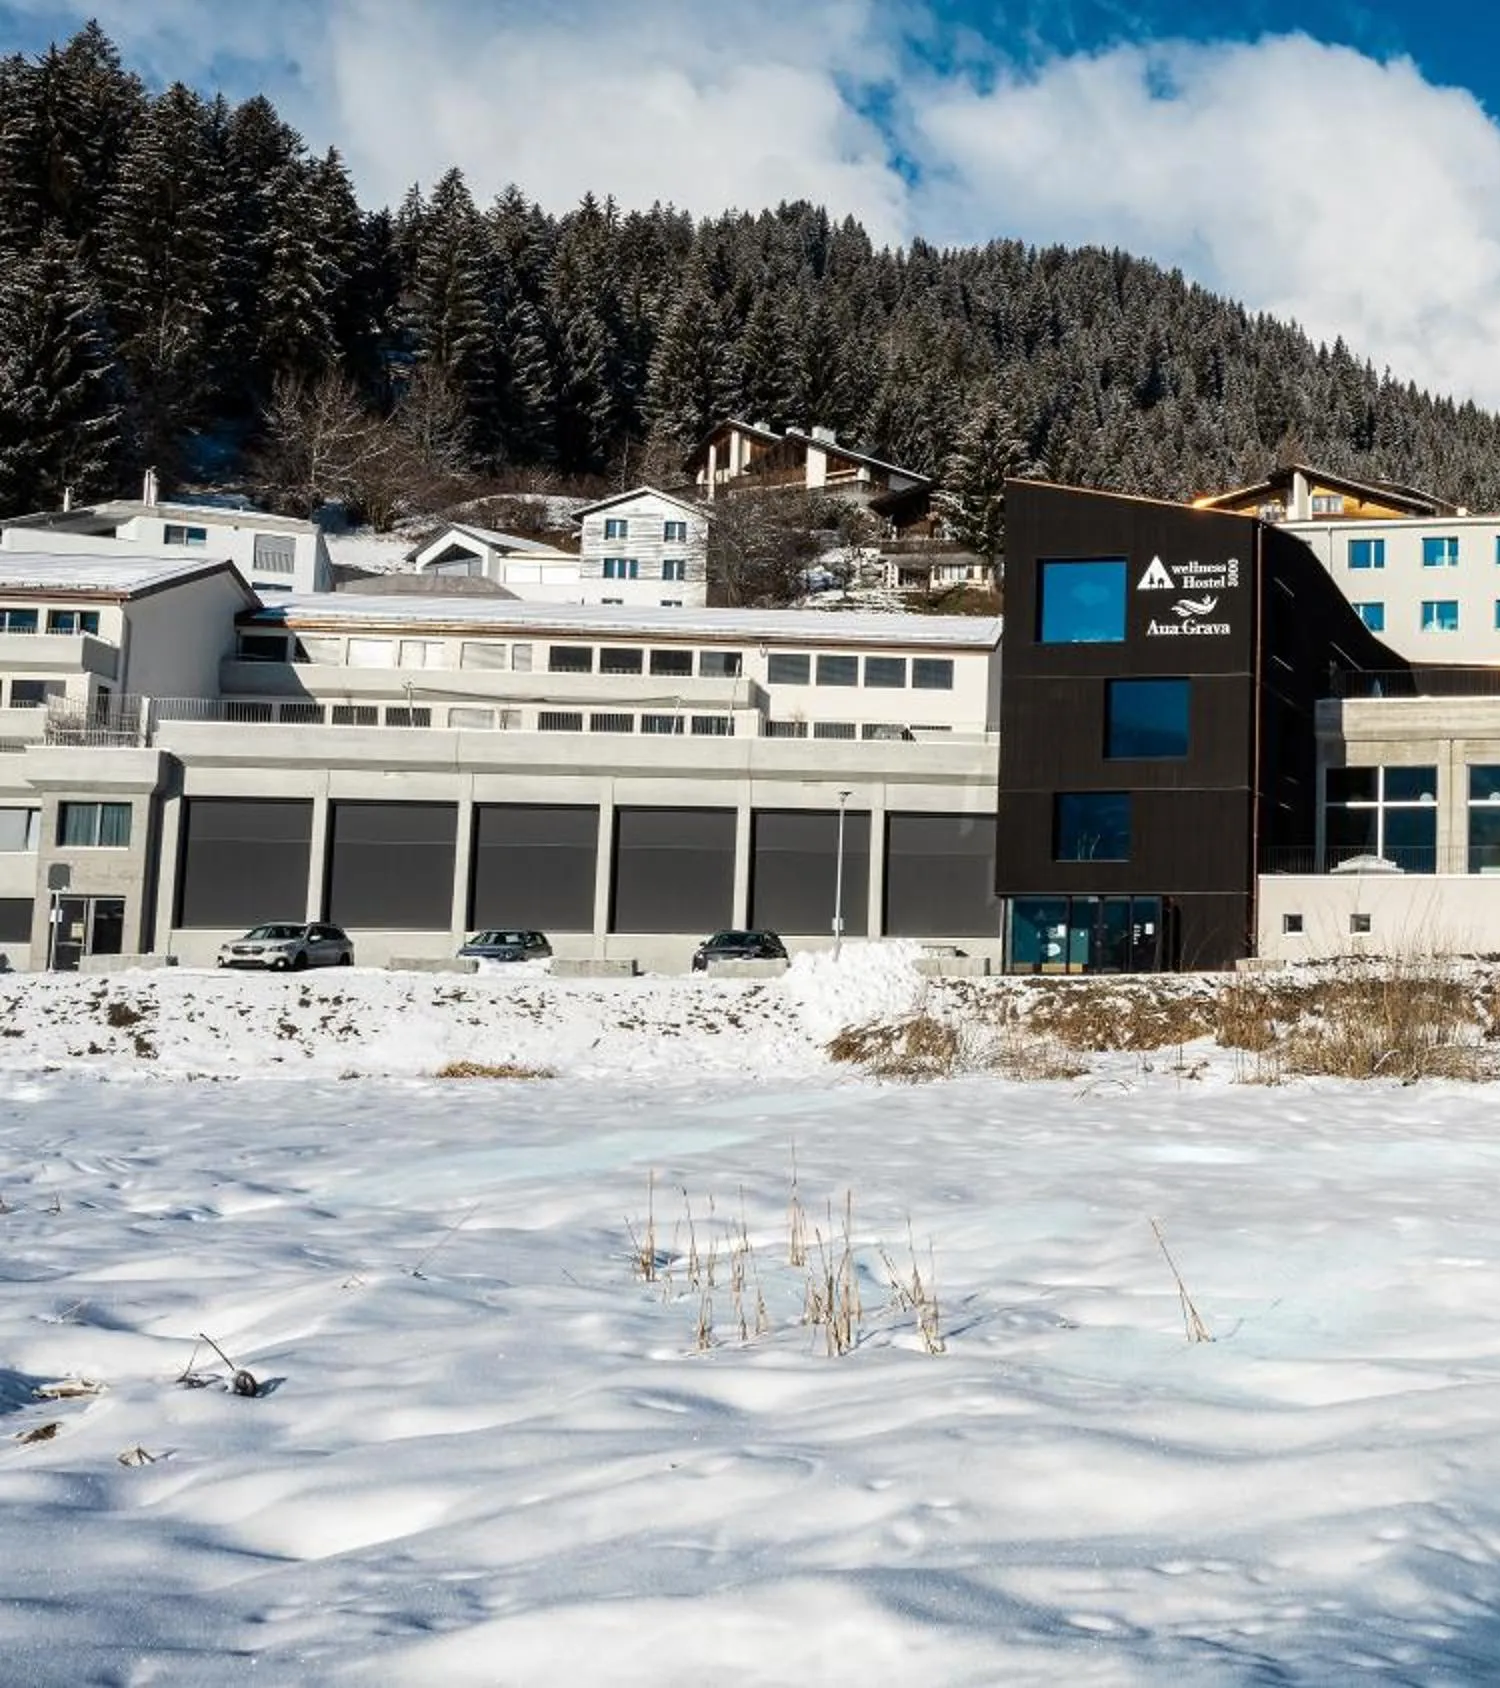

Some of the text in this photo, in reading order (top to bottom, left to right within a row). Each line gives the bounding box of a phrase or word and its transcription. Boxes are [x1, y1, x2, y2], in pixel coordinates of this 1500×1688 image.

[1171, 561, 1227, 575] wellness
[1182, 575, 1226, 589] Hostel
[1146, 618, 1231, 636] Aua Grava
